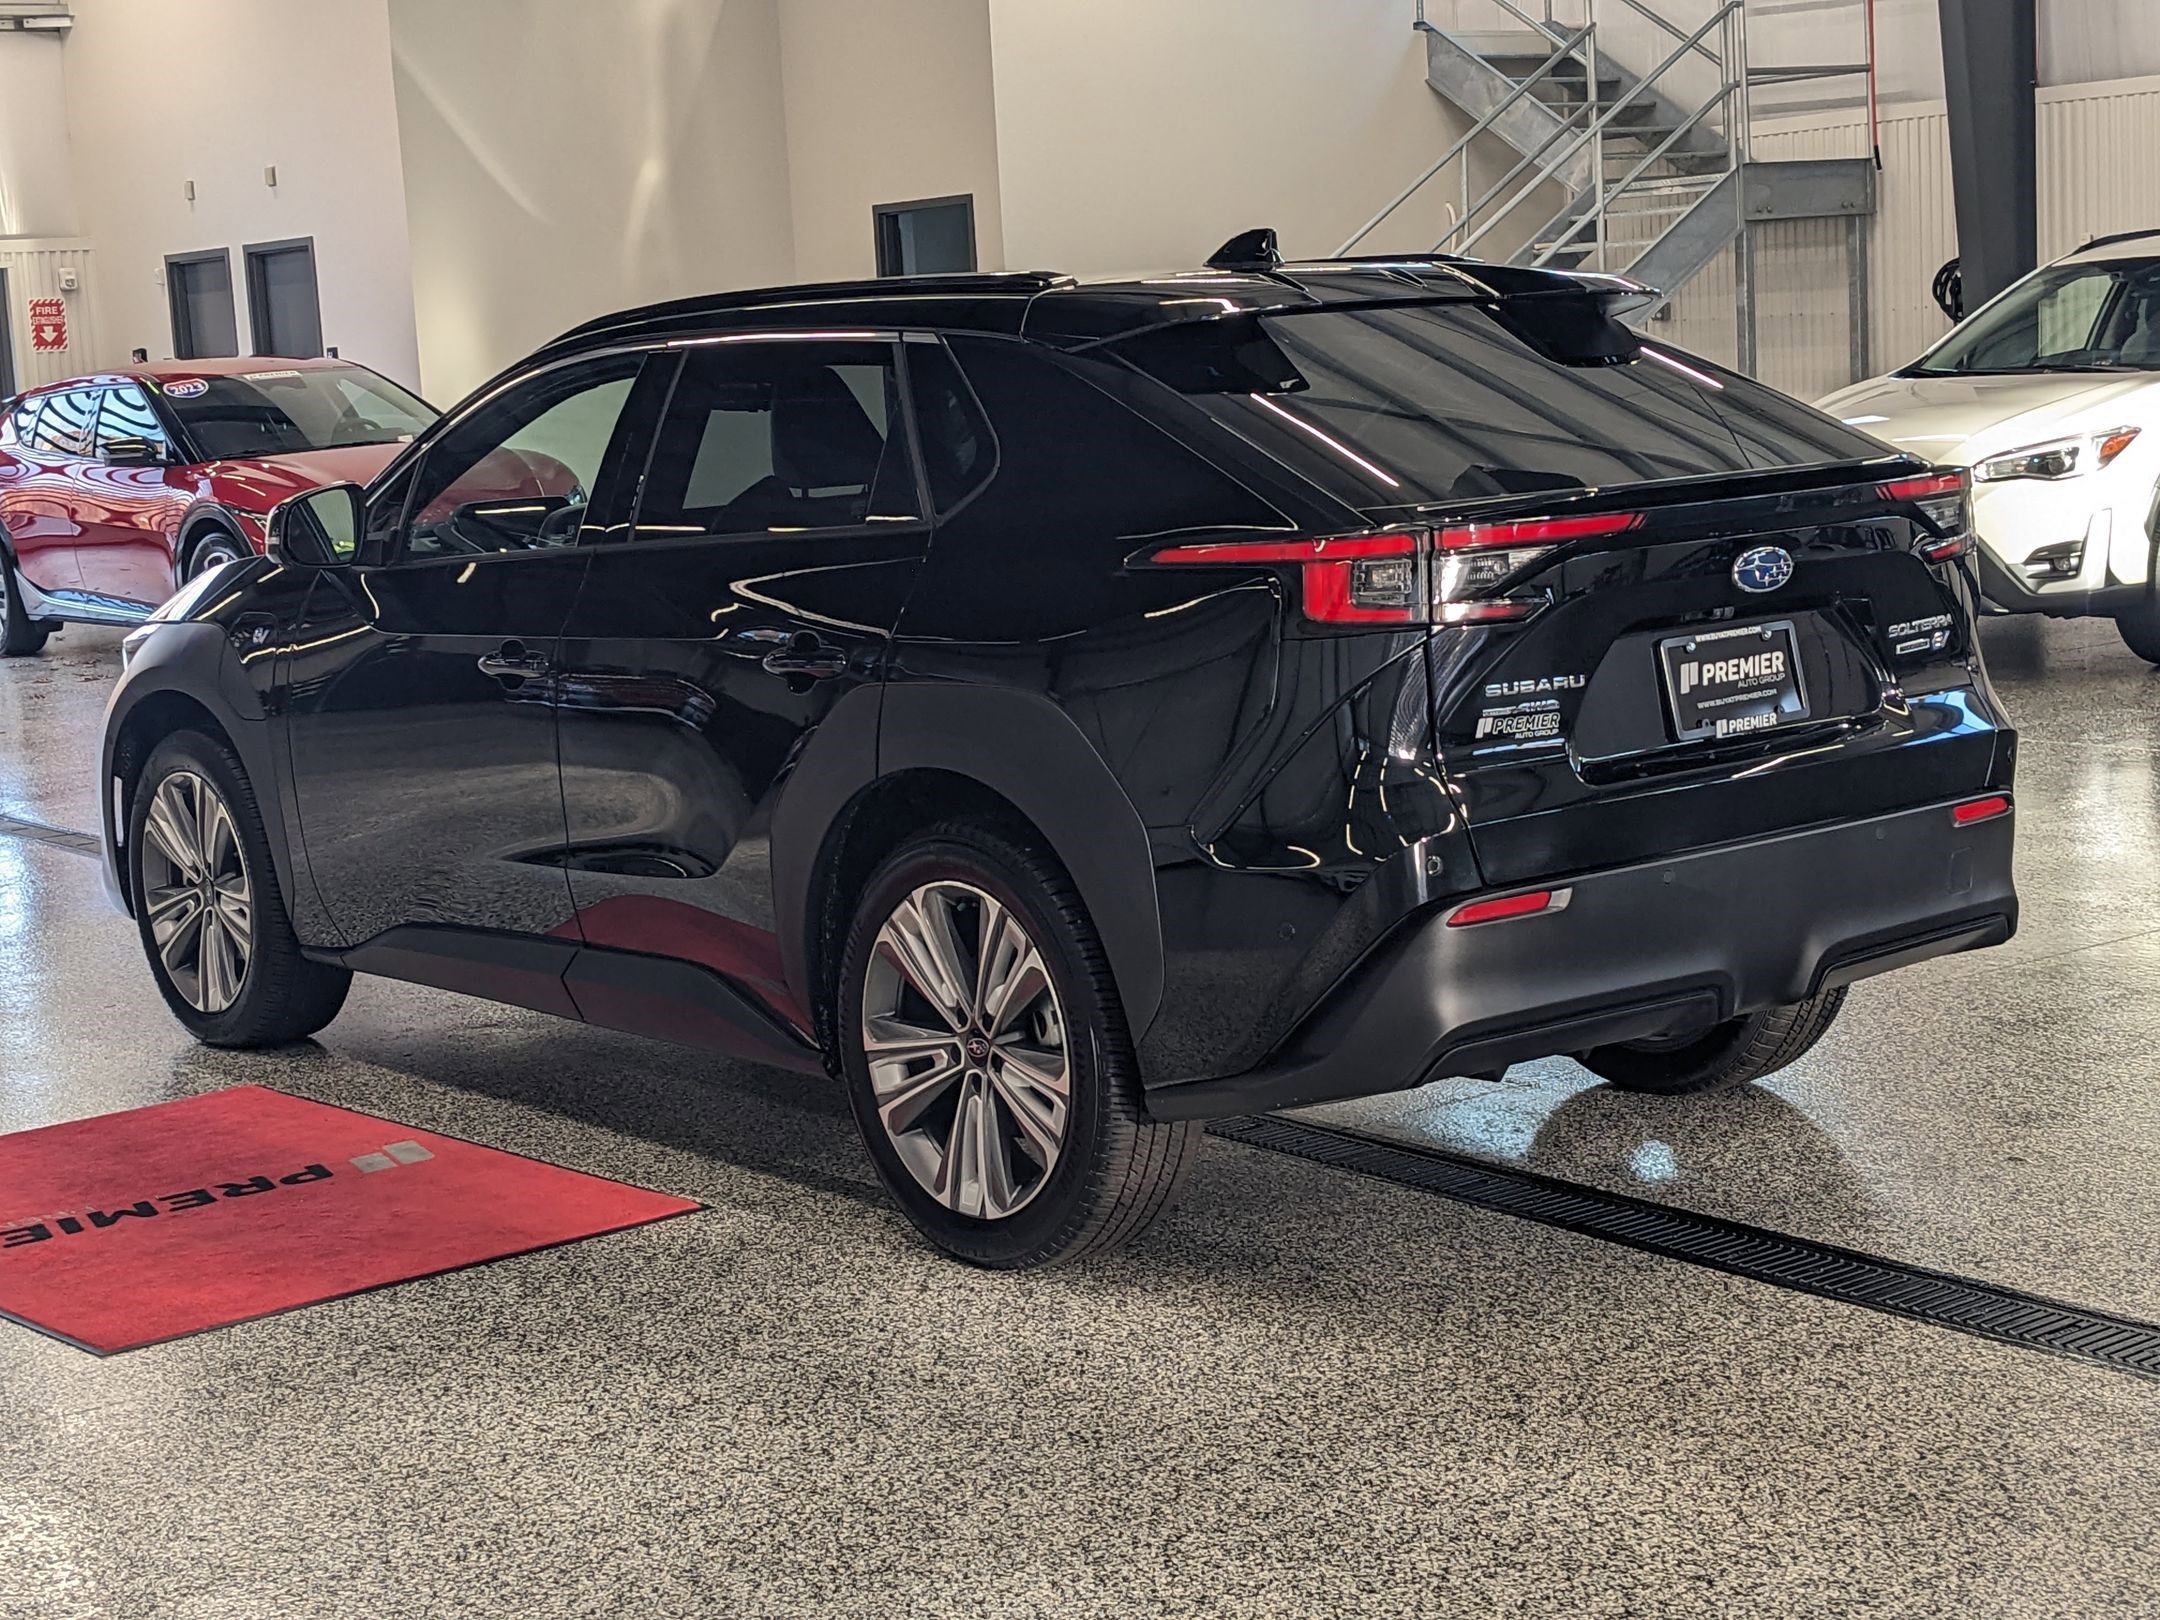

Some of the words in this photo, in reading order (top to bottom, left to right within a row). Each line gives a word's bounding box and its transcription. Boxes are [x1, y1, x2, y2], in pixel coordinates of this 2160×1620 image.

[35, 306, 59, 315] FIRE
[172, 382, 206, 395] 2023
[1888, 613, 1953, 638] SOLTERRA
[1702, 650, 1785, 686] PREMIER
[1485, 674, 1586, 697] SUBARU
[1738, 678, 1759, 688] AUTO
[1759, 672, 1786, 685] GROUP
[1492, 712, 1561, 735] PREMIER
[1515, 731, 1534, 740] AUTO
[1534, 728, 1560, 737] GROUP
[1729, 712, 1778, 734] PREMIER
